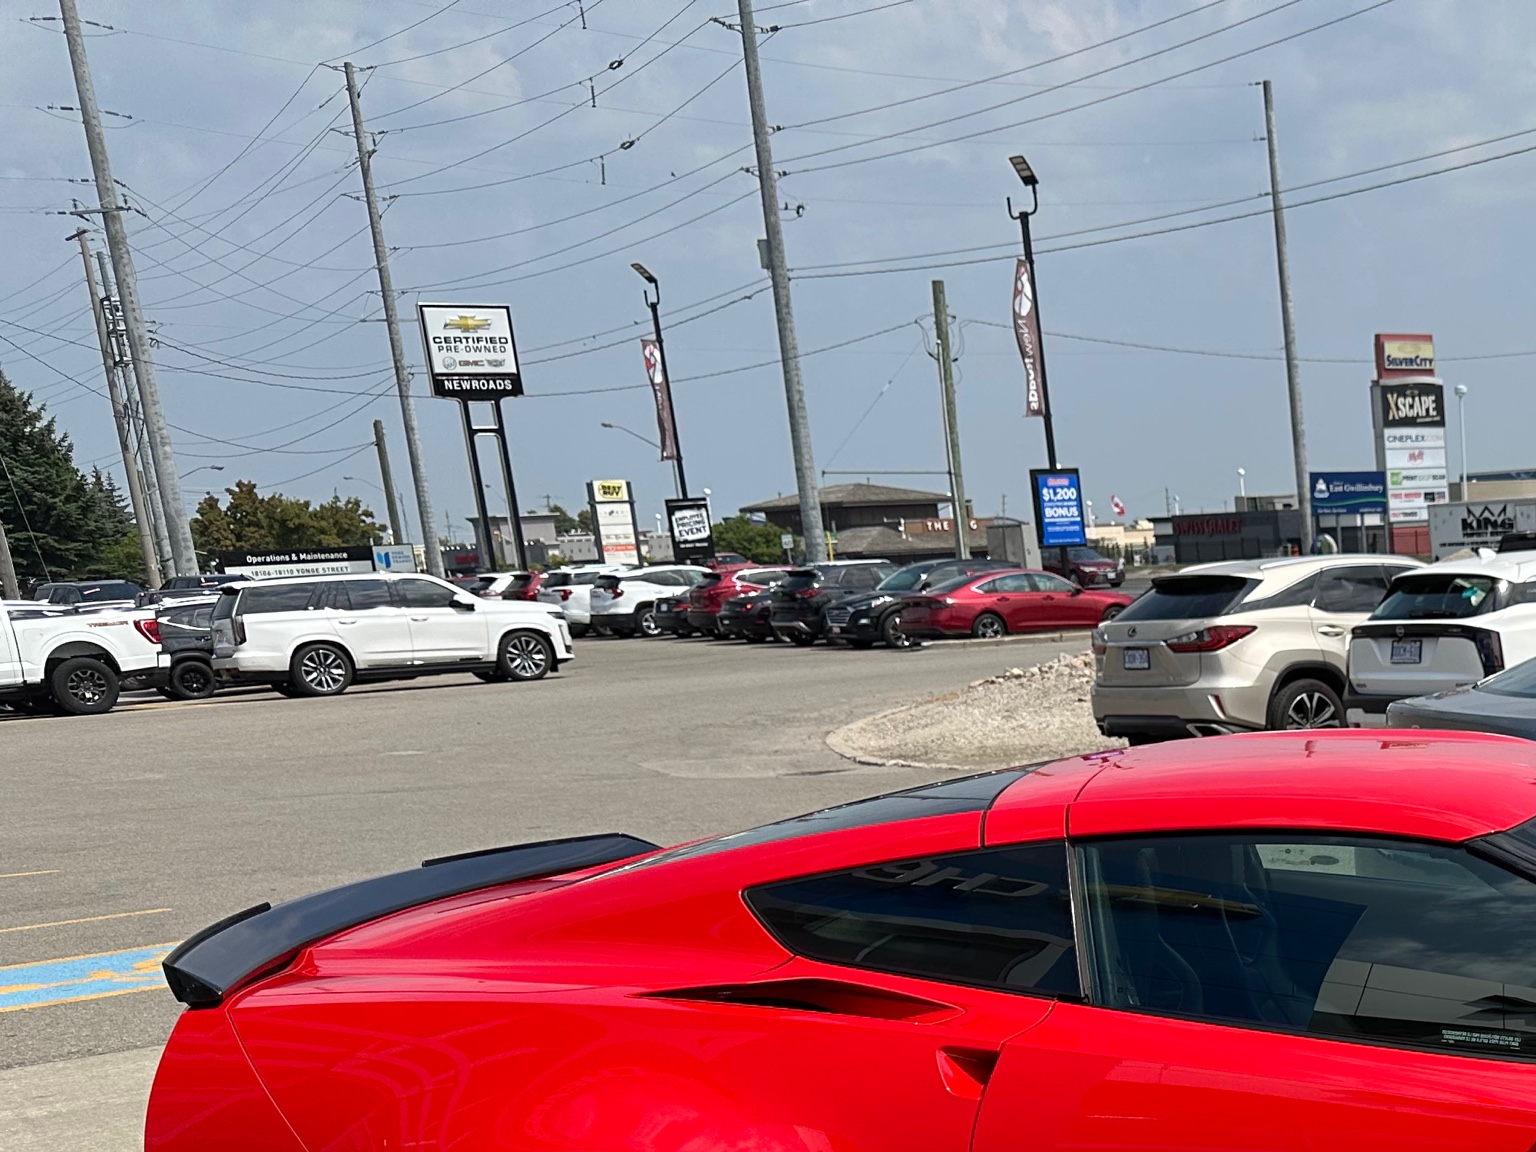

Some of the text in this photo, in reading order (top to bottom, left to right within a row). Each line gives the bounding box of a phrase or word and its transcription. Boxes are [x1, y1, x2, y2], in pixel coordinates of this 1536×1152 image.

[432, 336, 509, 345] CERTIFIED
[438, 345, 507, 353] PRE-OWNED
[444, 379, 512, 390] NEWROADS
[1386, 392, 1437, 420] XSCAPE
[1042, 487, 1077, 501] $1,200
[1044, 506, 1079, 517] BONUS
[926, 520, 949, 531] THE
[1461, 517, 1514, 531] KING
[680, 526, 707, 538] EVENT
[246, 553, 290, 564] Operations
[300, 552, 348, 560] Maintenance
[296, 568, 320, 576] YONGE
[322, 566, 349, 574] STREET
